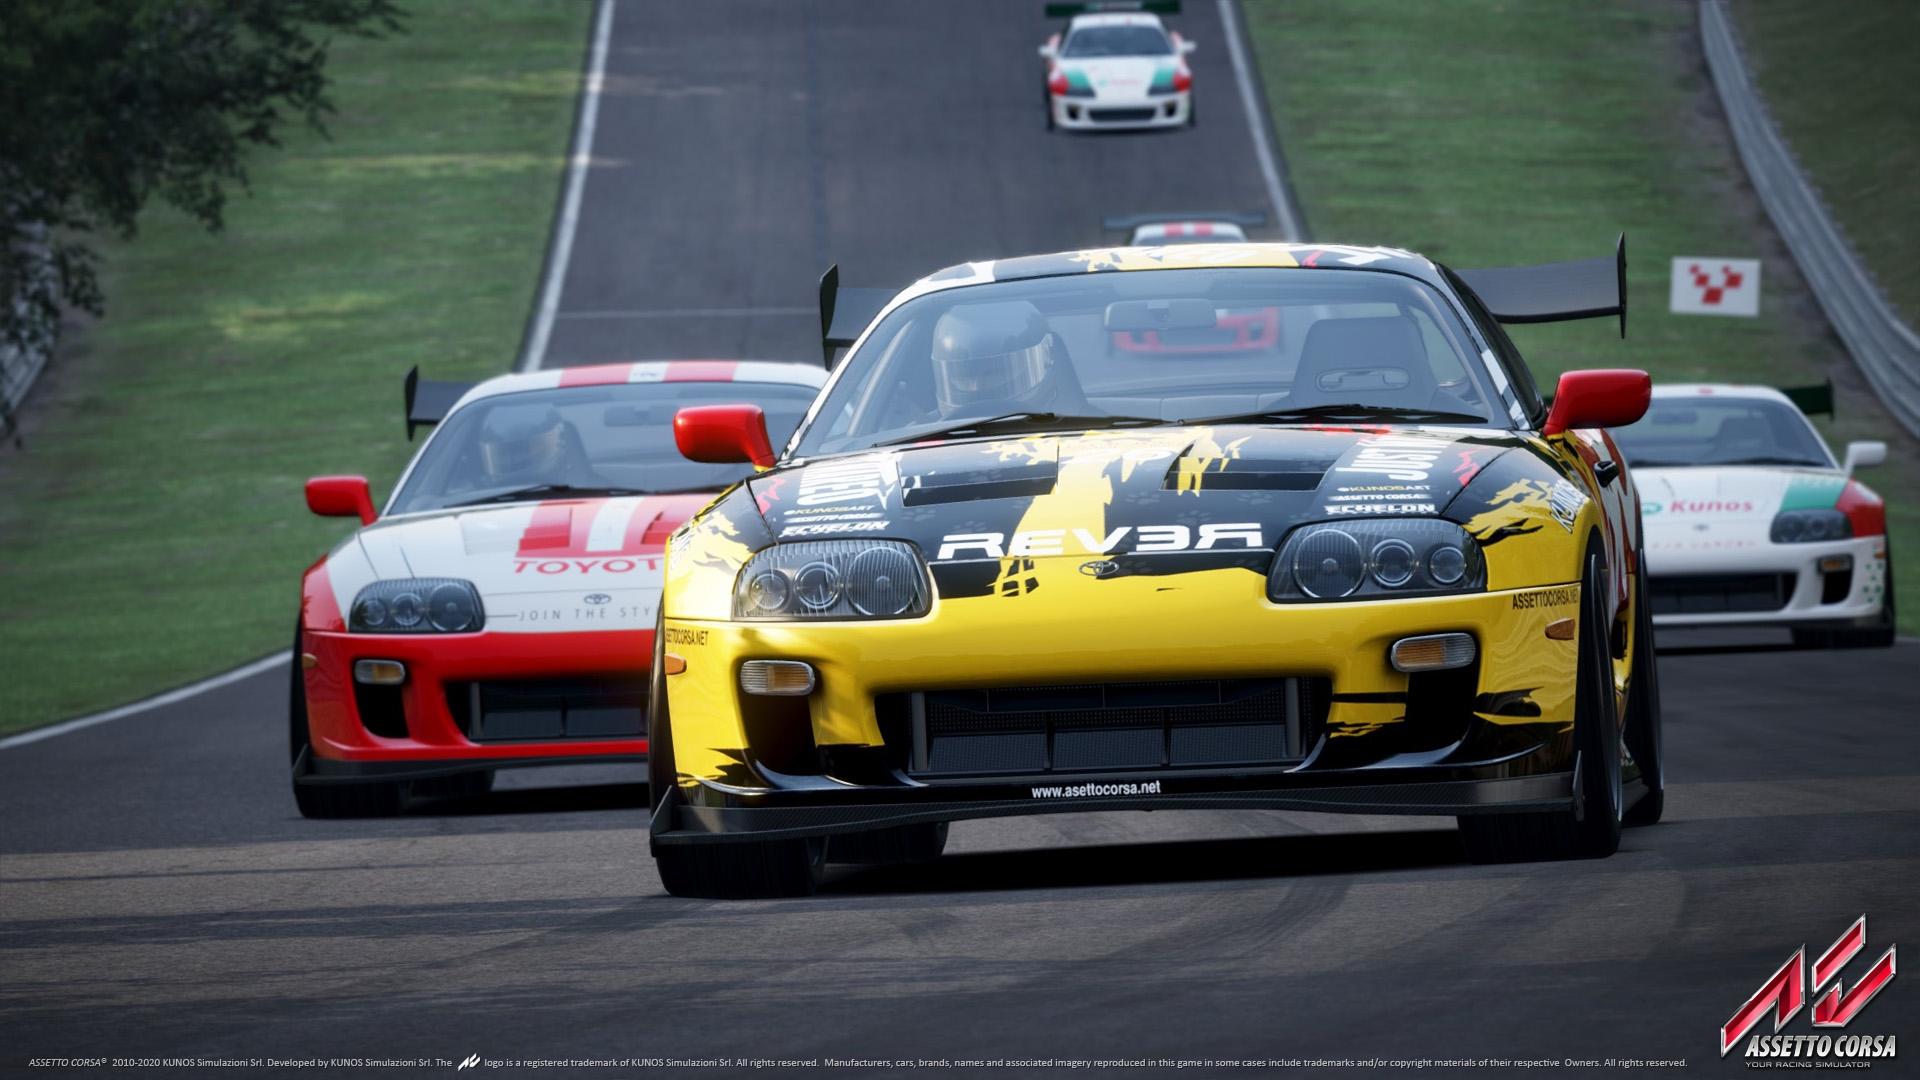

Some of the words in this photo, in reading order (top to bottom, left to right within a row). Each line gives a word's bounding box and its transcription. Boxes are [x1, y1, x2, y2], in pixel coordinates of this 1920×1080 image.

[1325, 503, 1439, 515] ECHELON
[1670, 500, 1754, 512] Kunos
[513, 559, 665, 574] TOYOT
[519, 610, 561, 621] JOIN
[575, 608, 606, 618] THE
[620, 607, 650, 617] STY
[1031, 779, 1161, 798] www.asettocorsa.net
